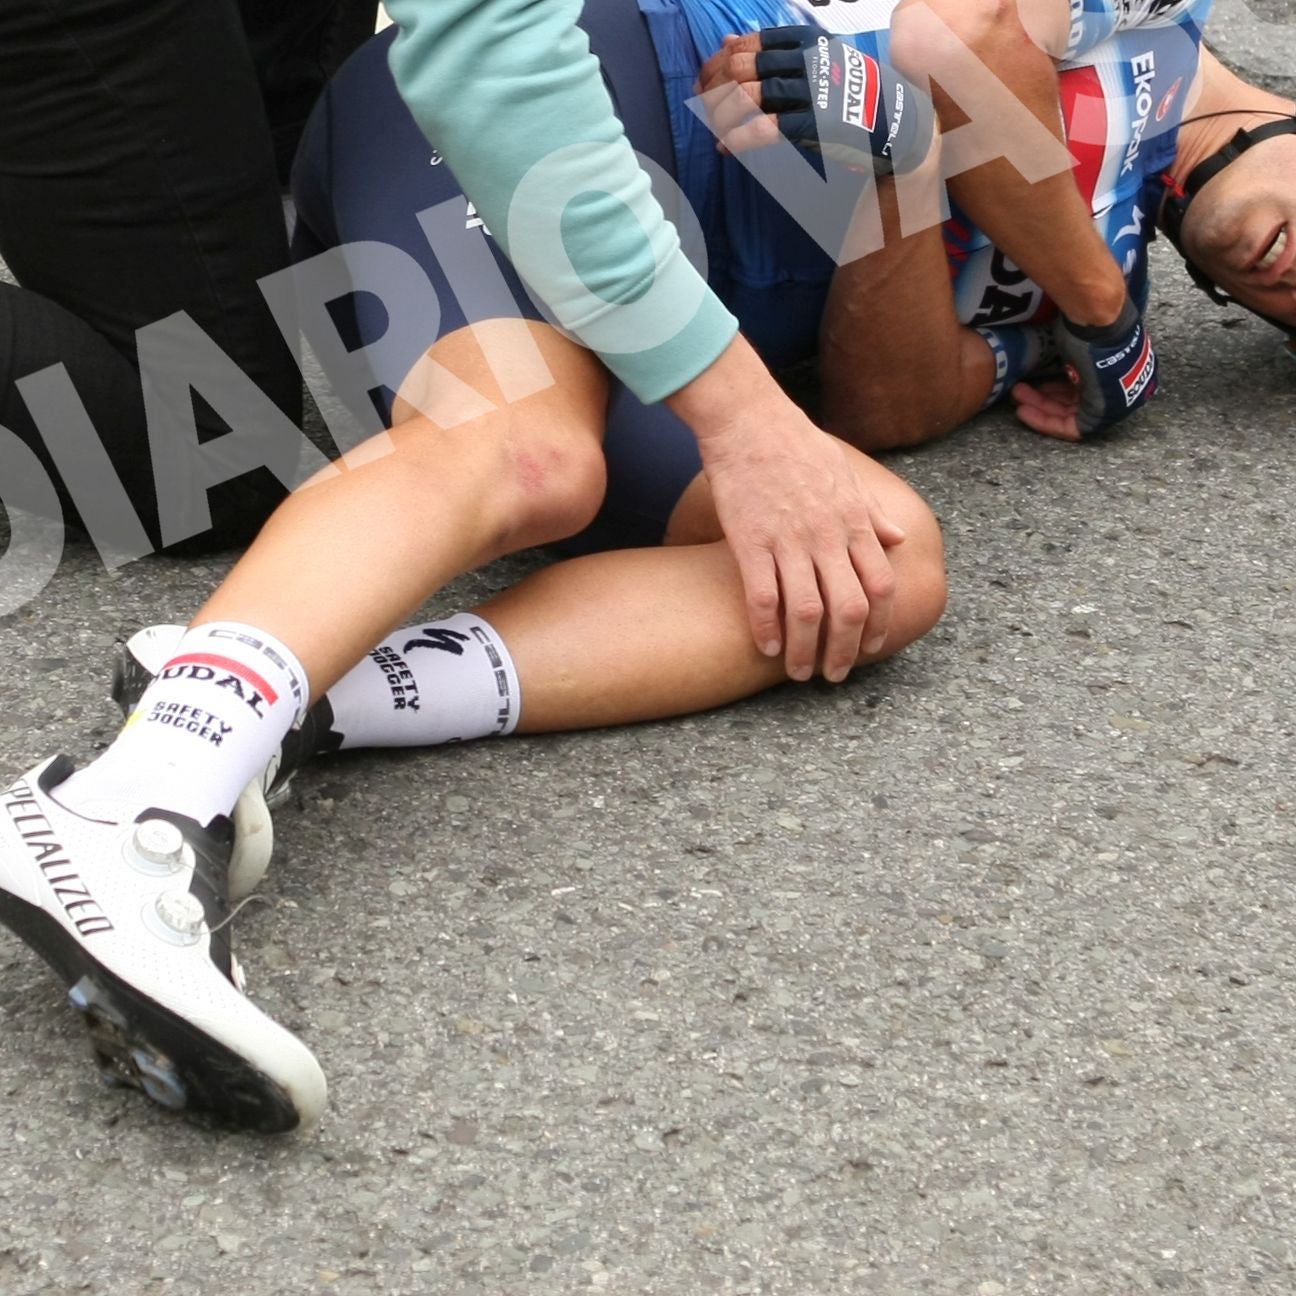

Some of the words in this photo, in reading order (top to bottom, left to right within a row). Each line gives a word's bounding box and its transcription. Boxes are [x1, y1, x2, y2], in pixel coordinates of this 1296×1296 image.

[846, 45, 864, 123] SOUDAL
[379, 646, 420, 712] SAFETY
[147, 712, 224, 747] JOGGER
[154, 701, 233, 735] SAFETY
